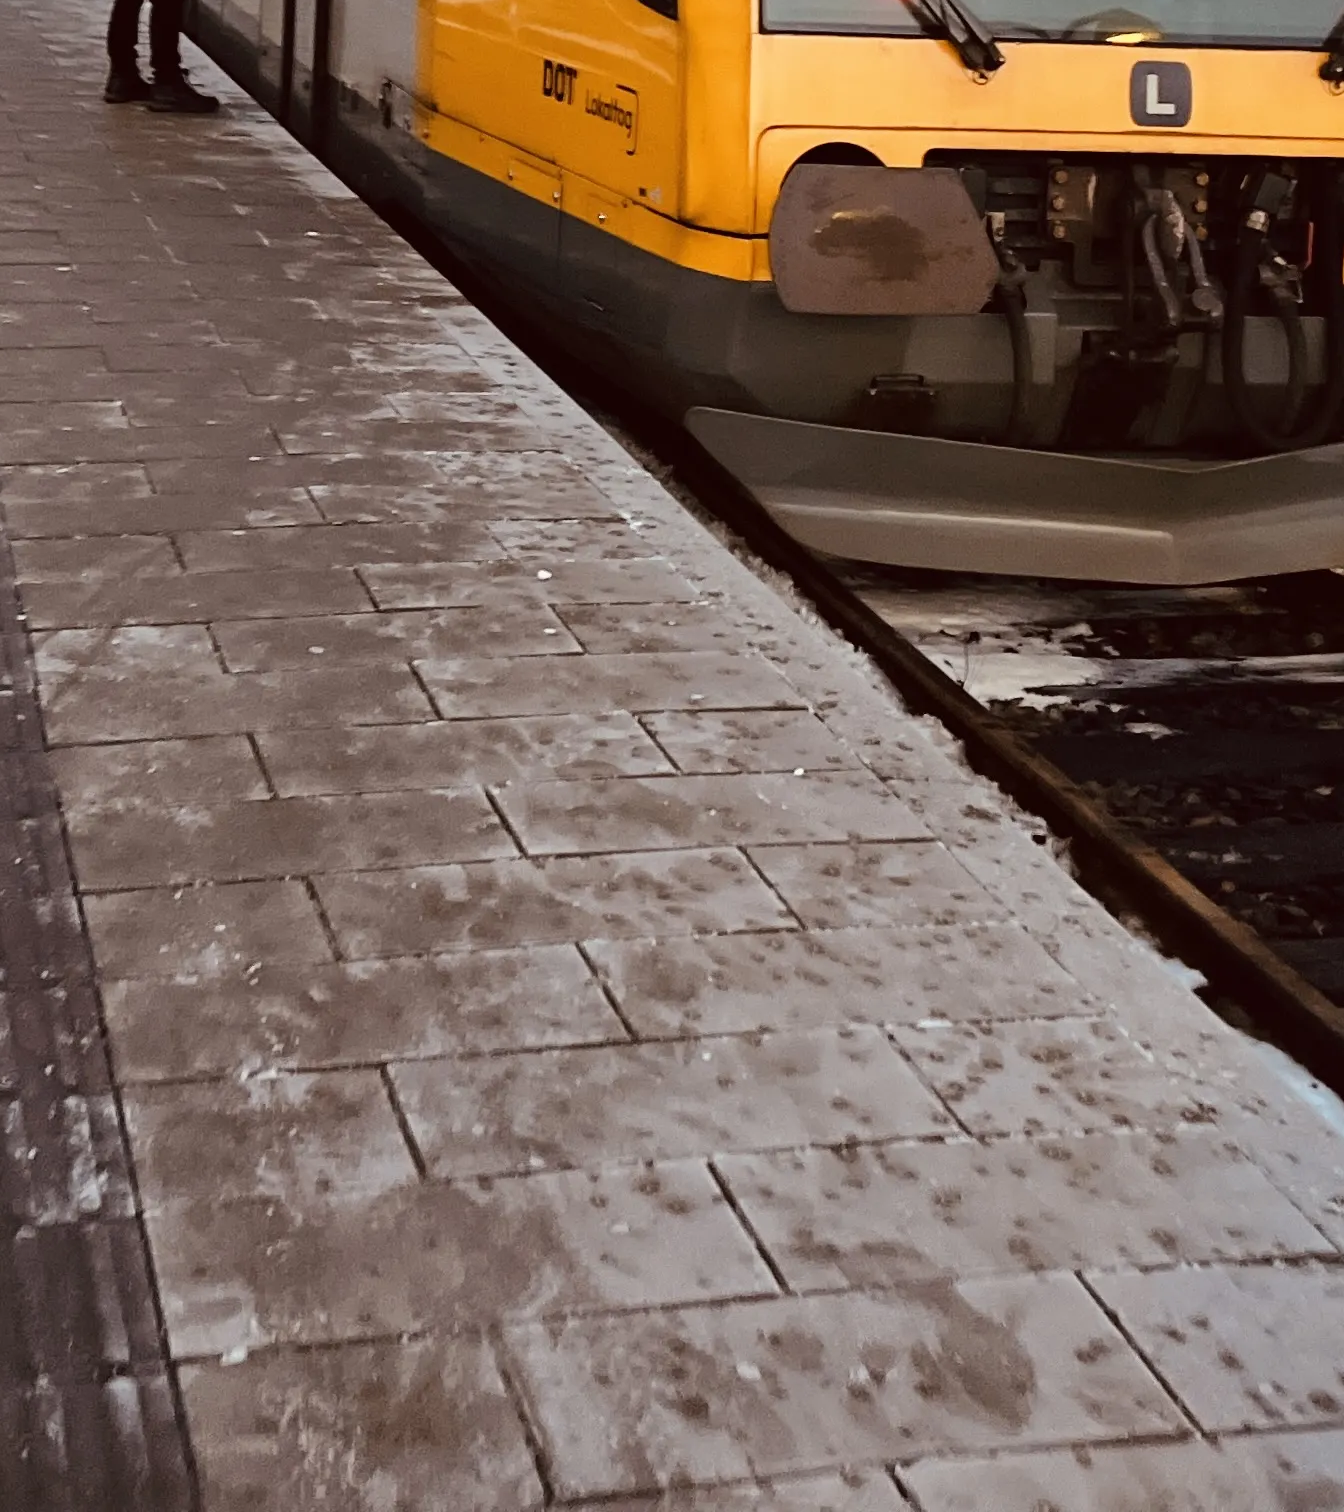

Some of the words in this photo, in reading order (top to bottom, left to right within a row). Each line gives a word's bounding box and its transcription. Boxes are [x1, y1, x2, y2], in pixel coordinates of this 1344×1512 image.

[543, 58, 578, 105] DOT
[585, 88, 632, 138] Lokaltog
[1146, 73, 1176, 115] L
